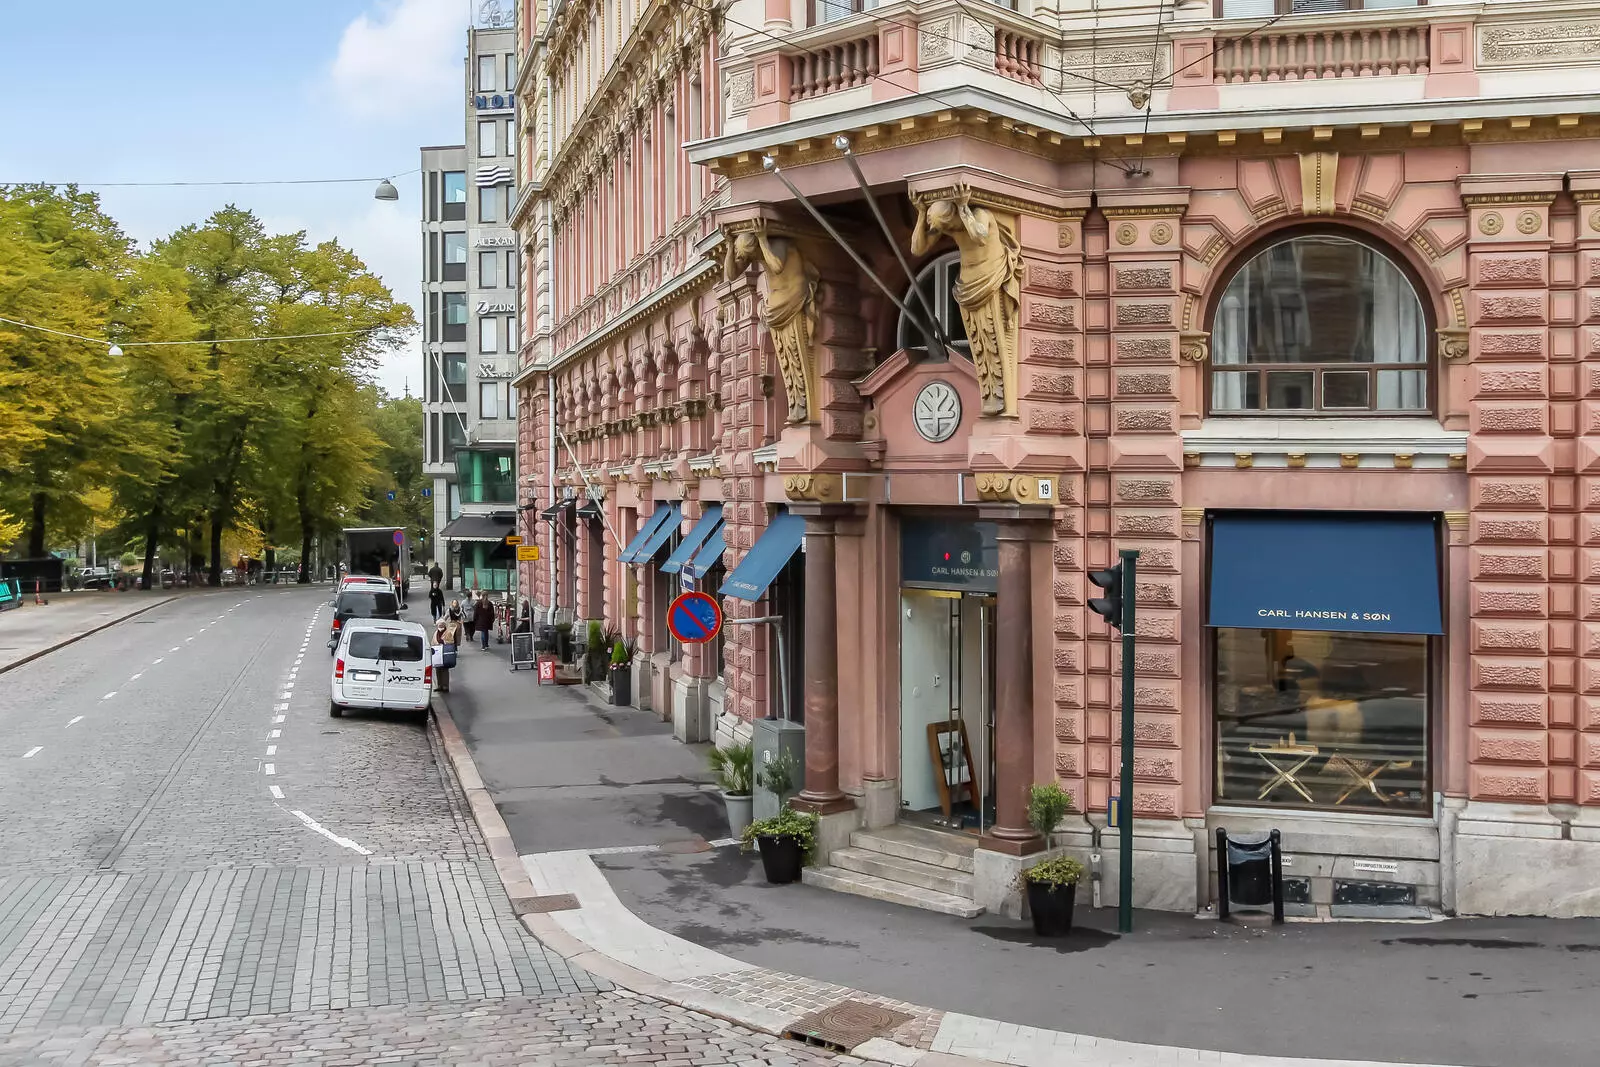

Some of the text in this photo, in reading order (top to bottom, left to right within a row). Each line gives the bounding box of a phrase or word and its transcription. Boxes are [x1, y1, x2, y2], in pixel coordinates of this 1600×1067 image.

[1041, 484, 1049, 494] 19
[931, 566, 950, 575] CARL
[950, 567, 978, 576] HANSEN
[1257, 609, 1391, 621] CARL HANSEN & SØN
